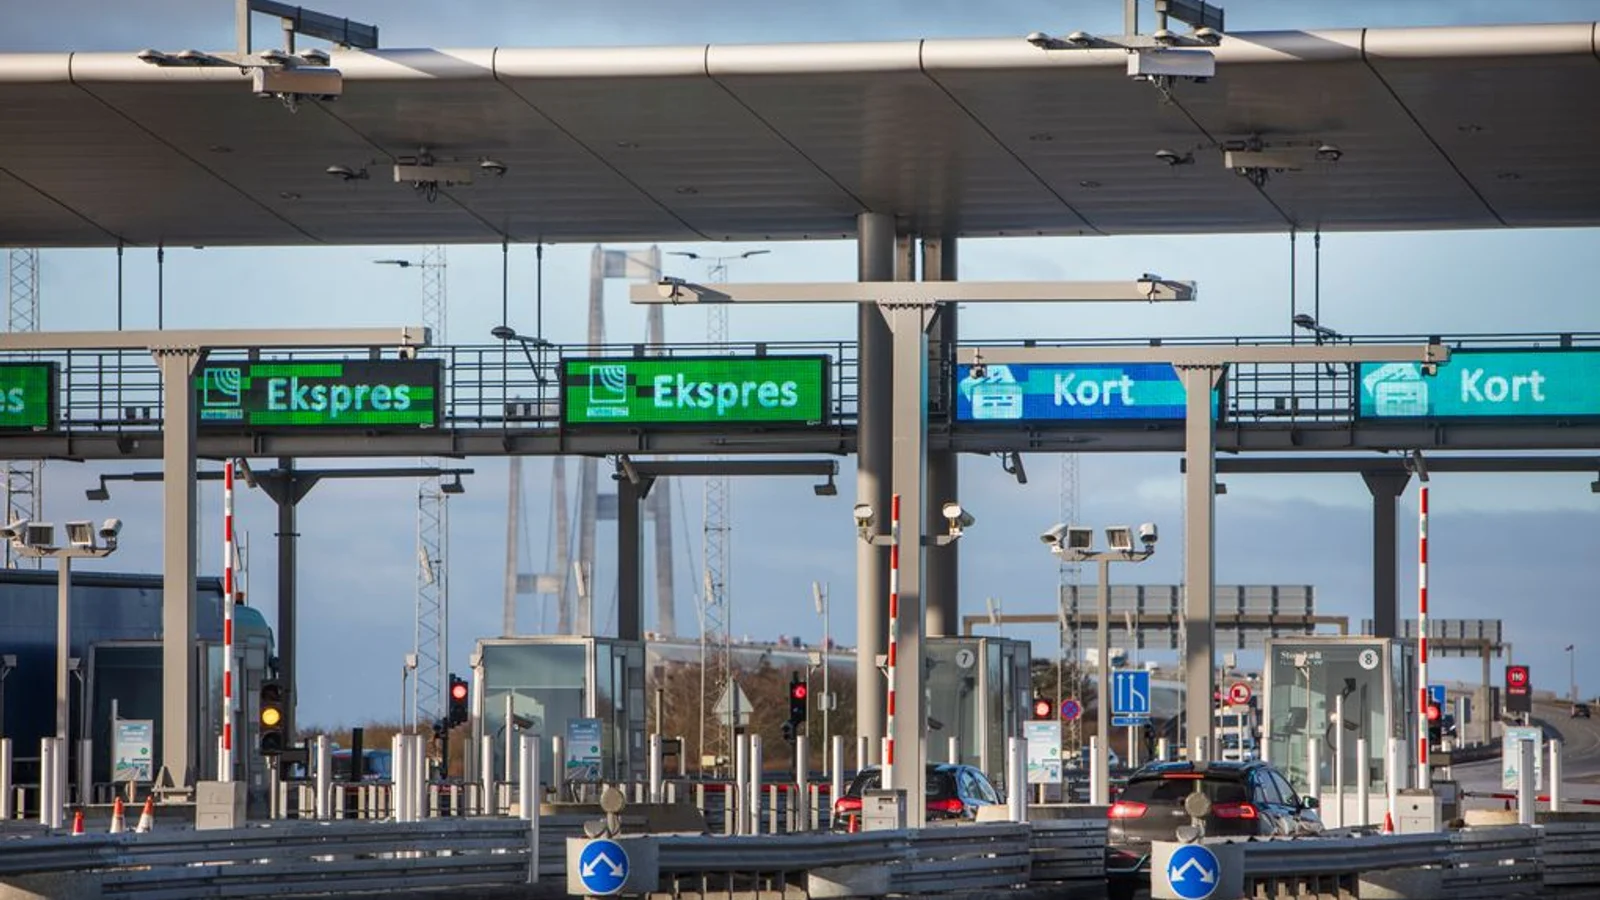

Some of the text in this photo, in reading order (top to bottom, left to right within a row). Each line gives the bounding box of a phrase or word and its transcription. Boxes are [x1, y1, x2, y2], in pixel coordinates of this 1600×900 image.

[268, 376, 411, 418] Ekspres
[654, 373, 798, 416] Ekspres
[1054, 372, 1135, 406] Kort
[1461, 368, 1545, 402] Kort
[962, 652, 969, 665] 7
[1365, 653, 1372, 665] 8
[1512, 672, 1524, 681] 110
